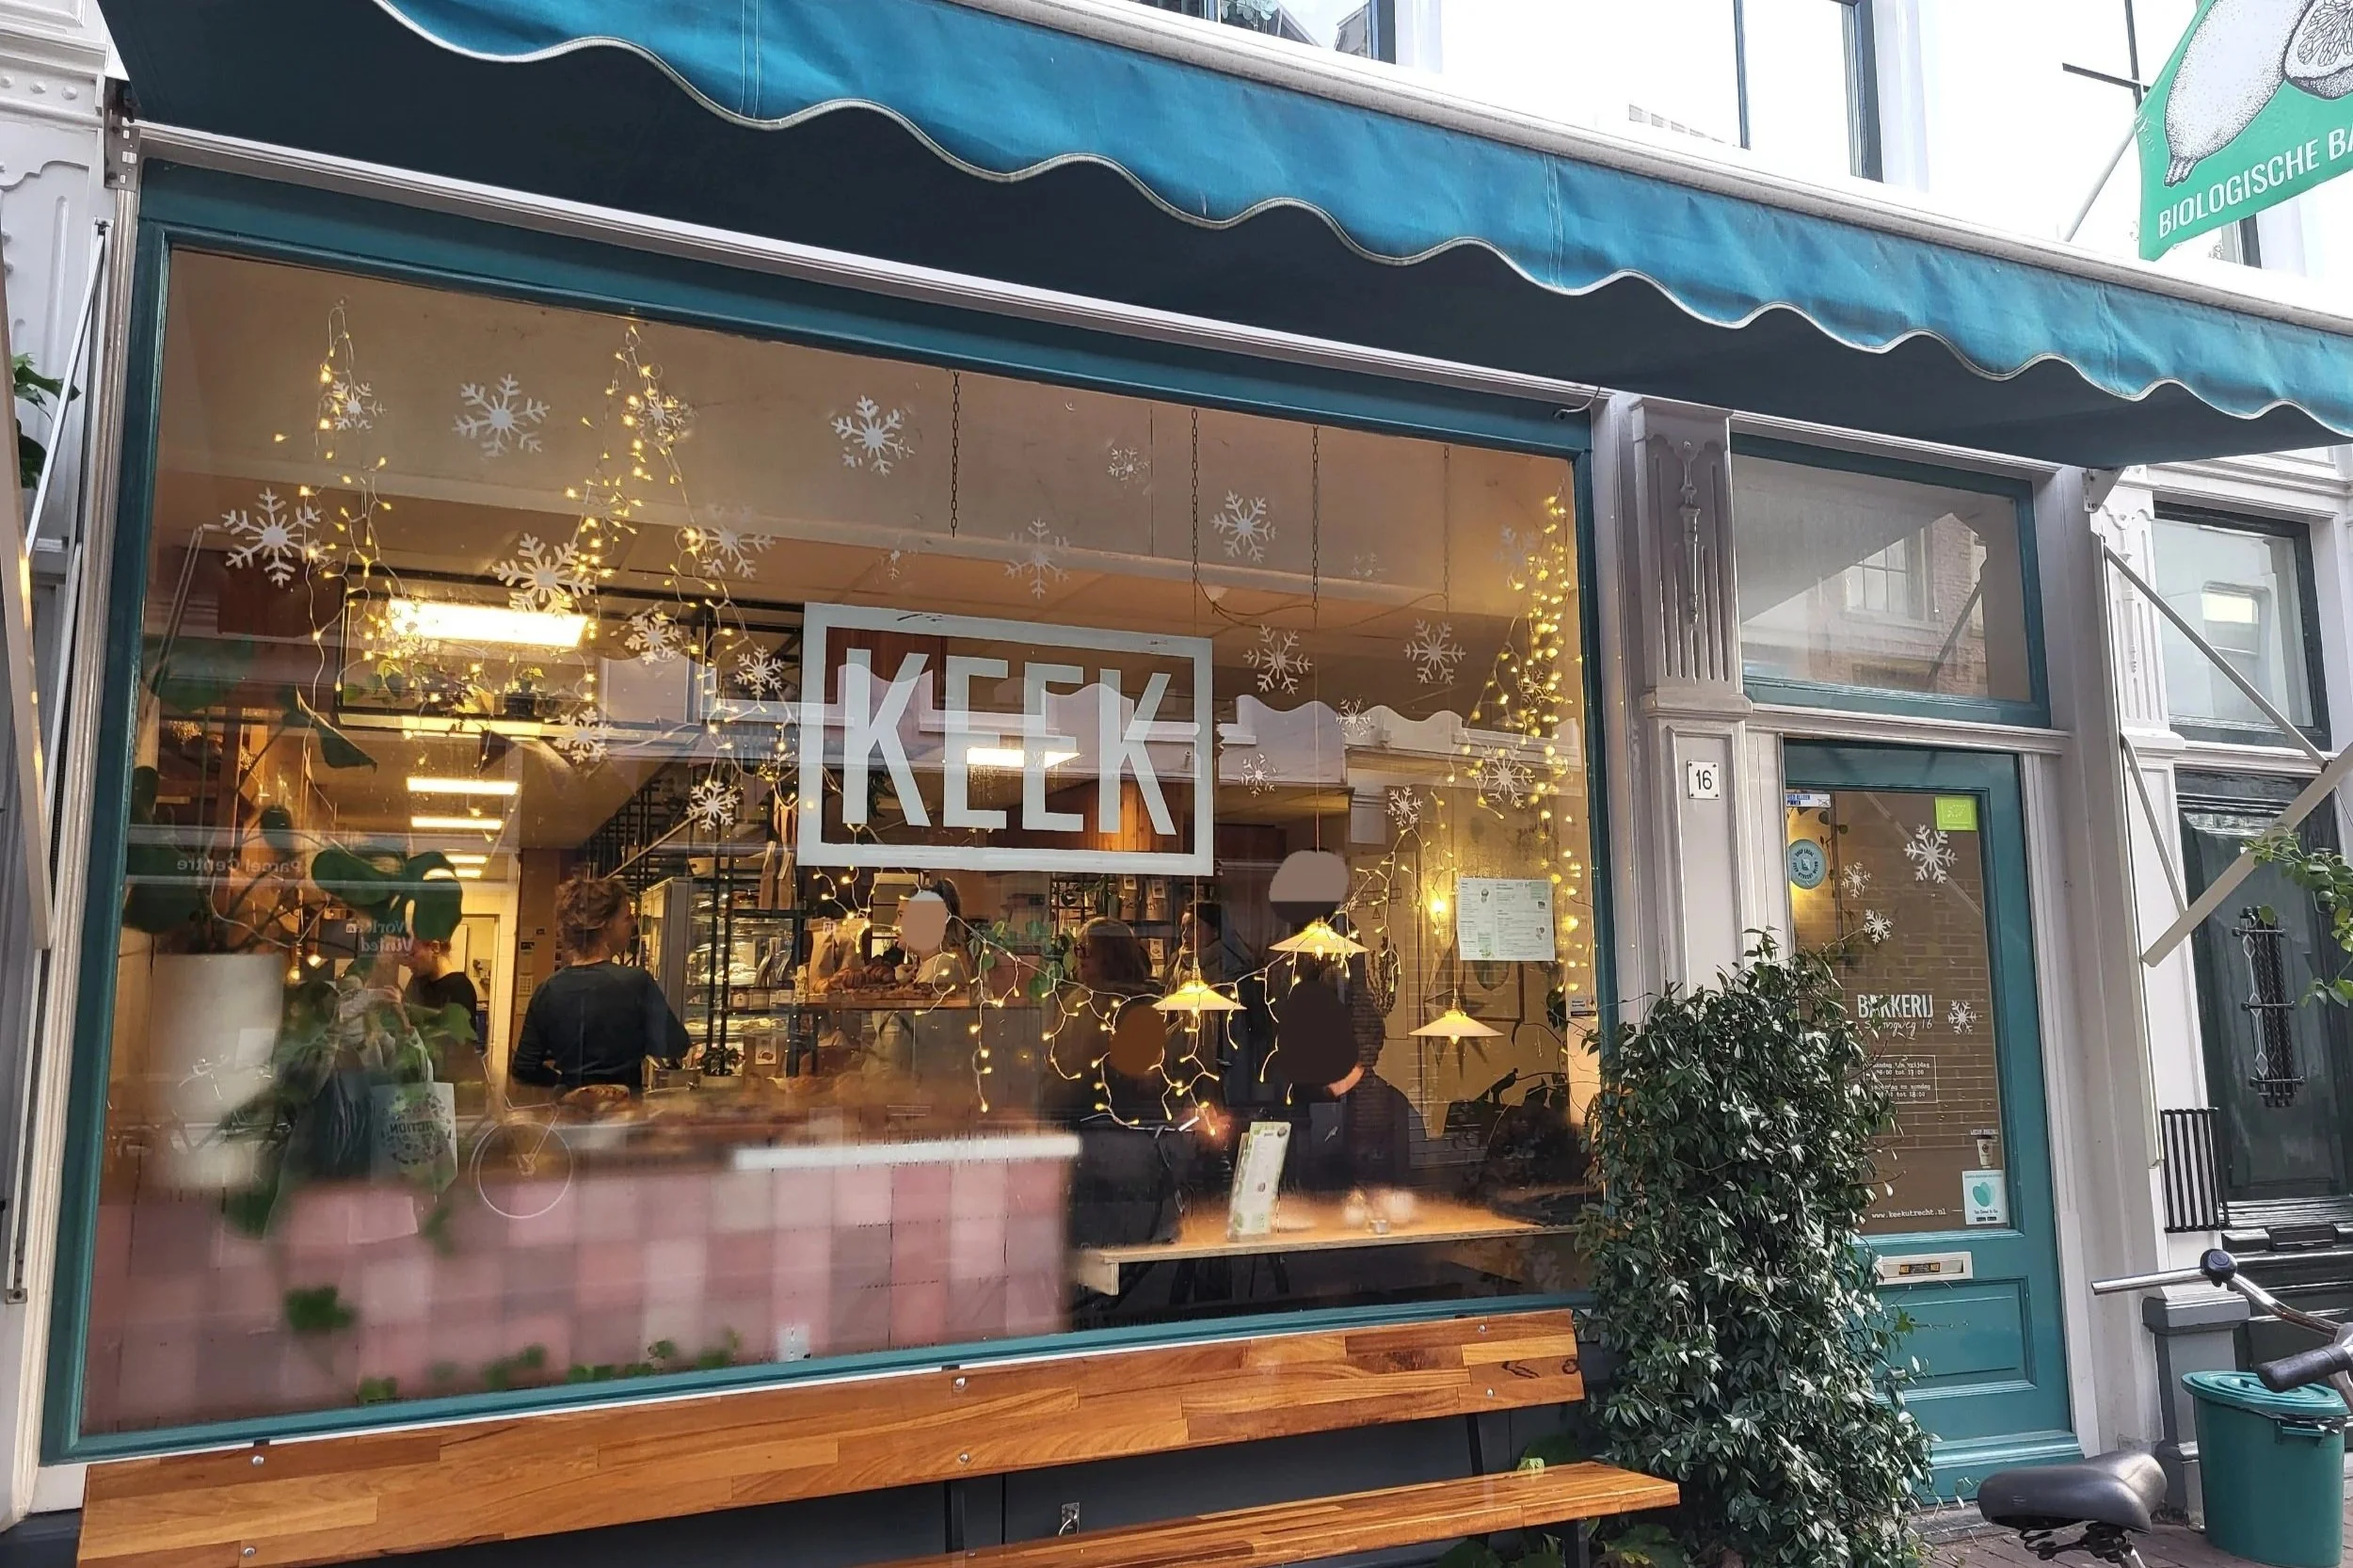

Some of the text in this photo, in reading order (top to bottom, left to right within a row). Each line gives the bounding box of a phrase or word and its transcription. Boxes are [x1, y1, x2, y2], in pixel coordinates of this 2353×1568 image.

[2159, 138, 2319, 239] BIOLOGISCHE
[842, 648, 1176, 836] KEEK
[1695, 769, 1712, 791] 16
[1864, 1018, 1933, 1038] Singweg 16
[1871, 1208, 1946, 1219] www.keekutrecht.nl
